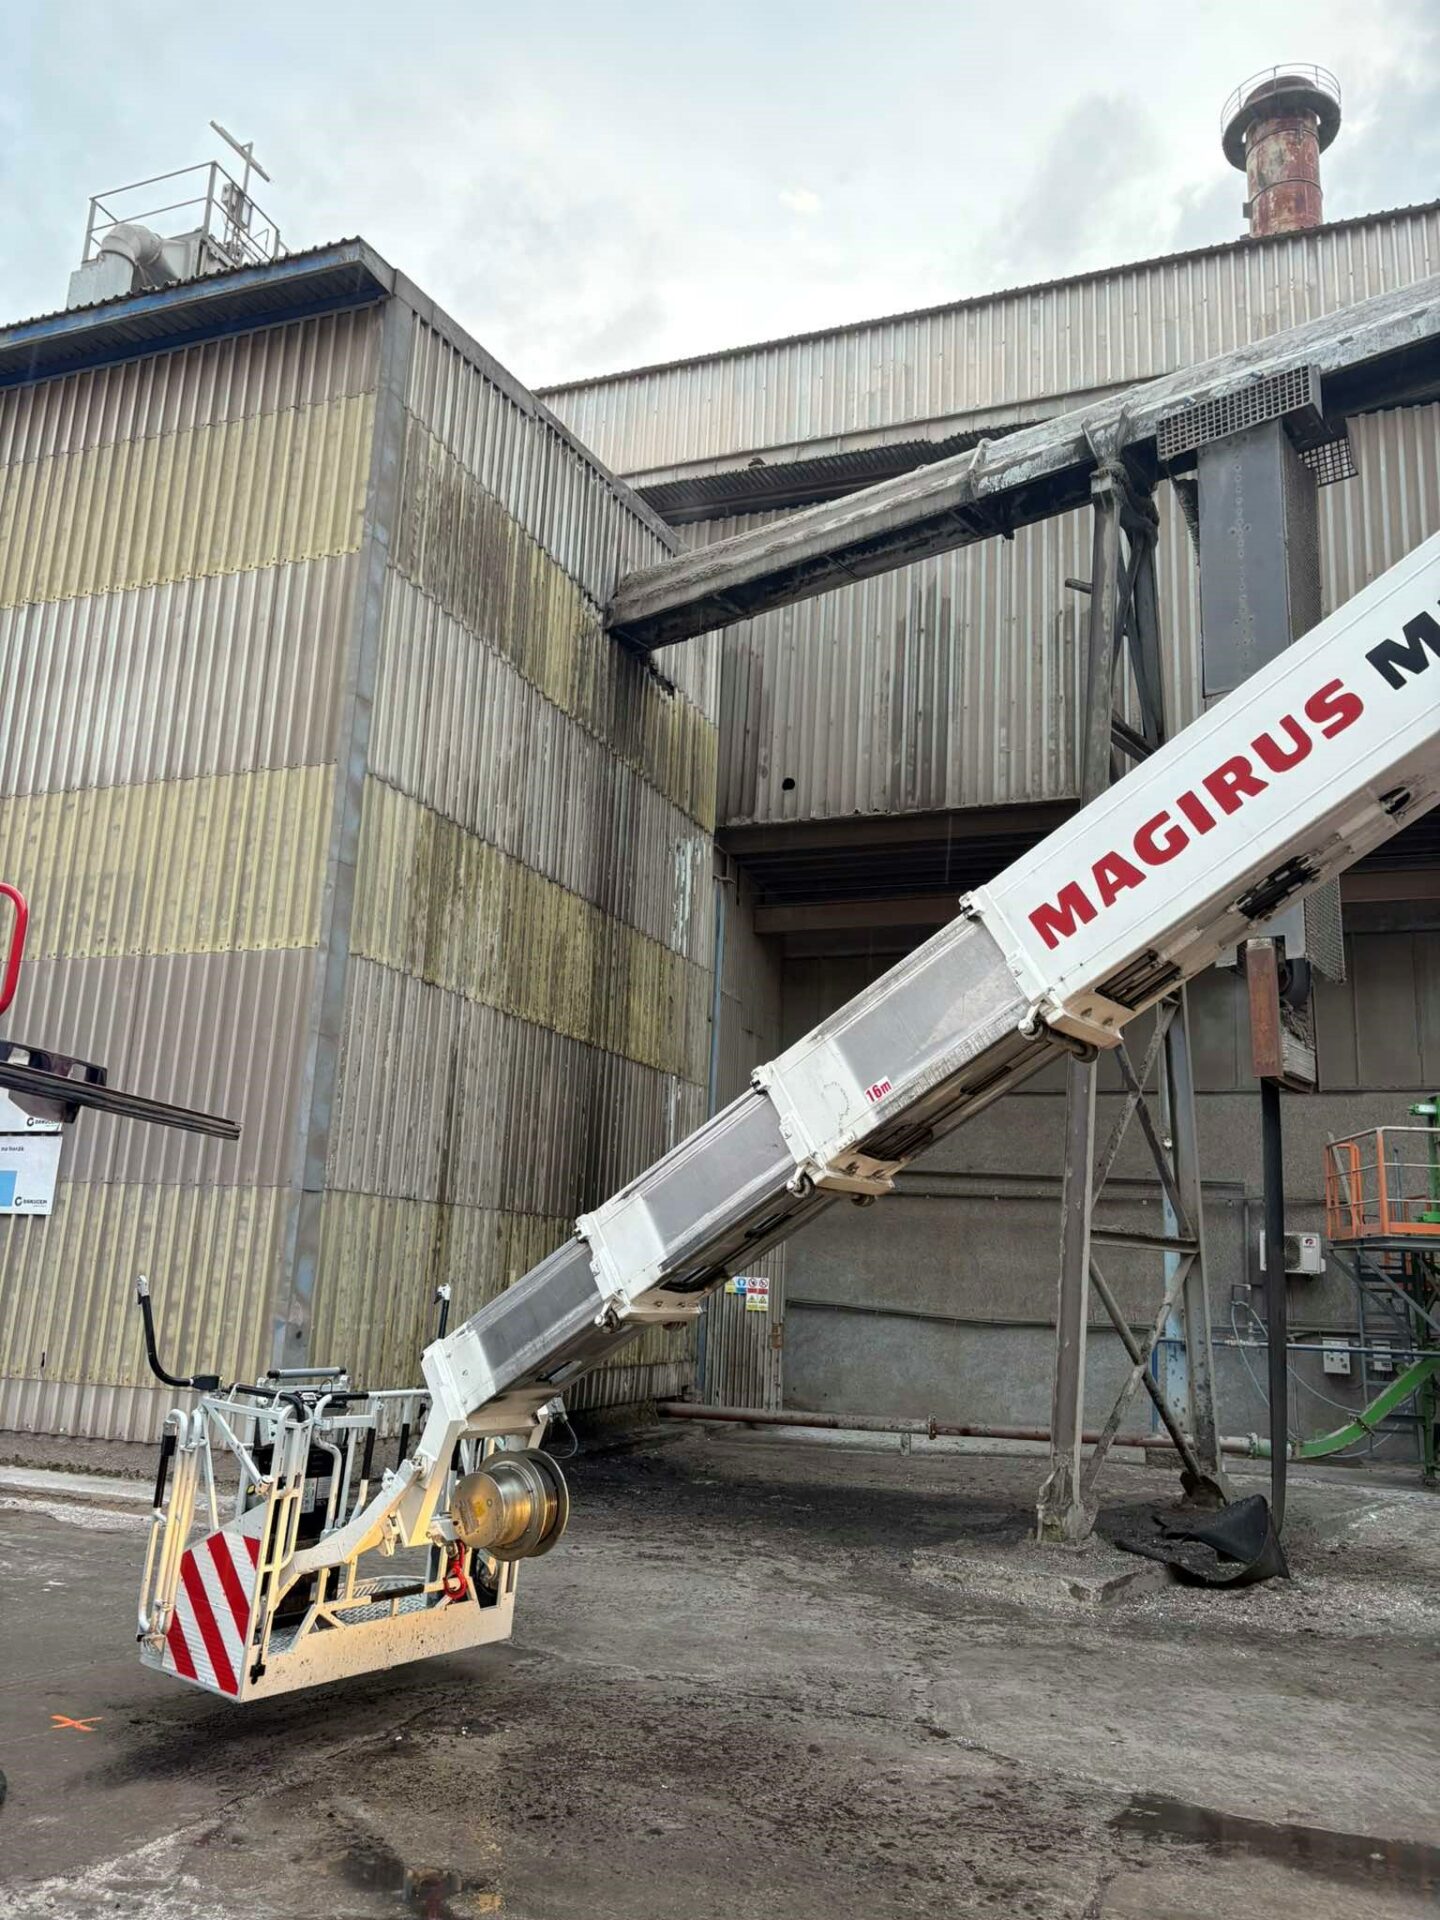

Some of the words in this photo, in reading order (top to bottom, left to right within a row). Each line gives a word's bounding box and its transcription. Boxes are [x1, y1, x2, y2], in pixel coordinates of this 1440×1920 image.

[1028, 678, 1364, 950] MAGIRUS
[1365, 599, 1440, 690] M
[865, 1081, 892, 1102] 16m
